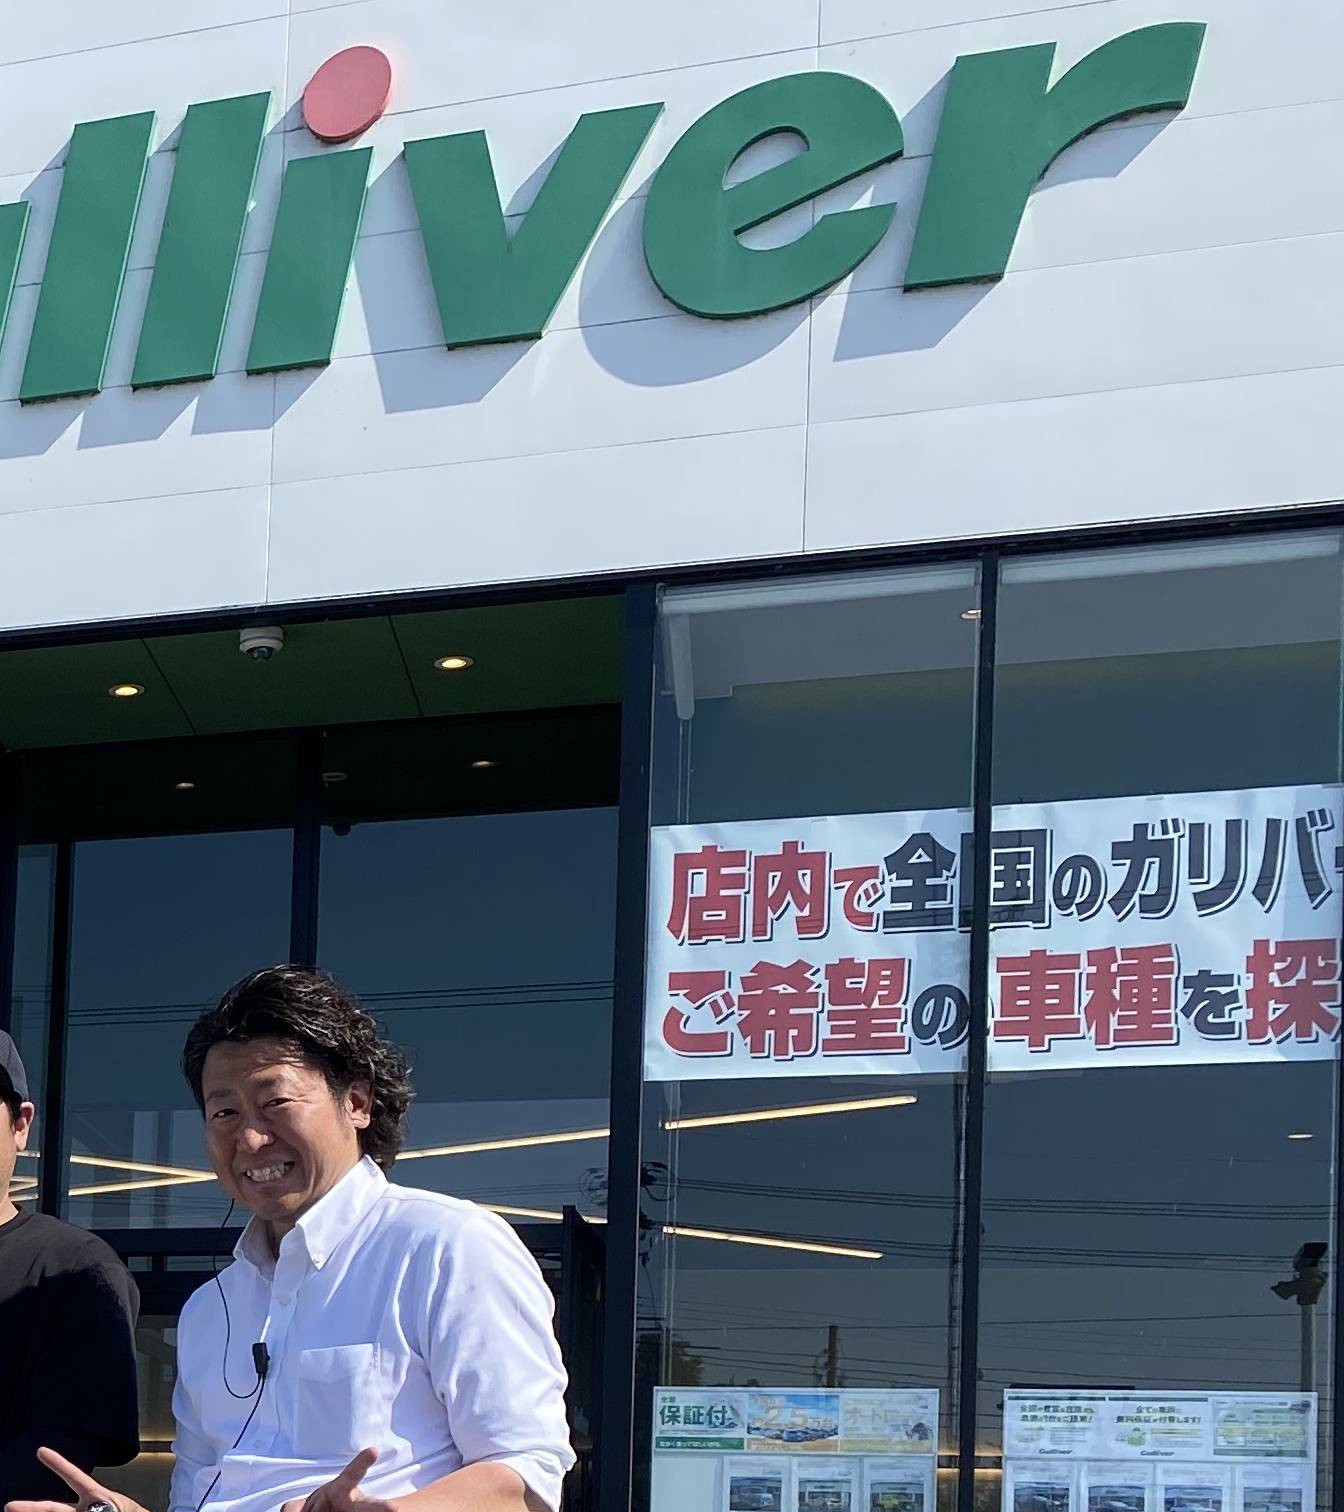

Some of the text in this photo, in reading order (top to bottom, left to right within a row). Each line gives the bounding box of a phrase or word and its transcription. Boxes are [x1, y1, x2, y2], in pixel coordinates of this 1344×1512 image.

[666, 808, 1344, 945] 店内で全国のガリバ
